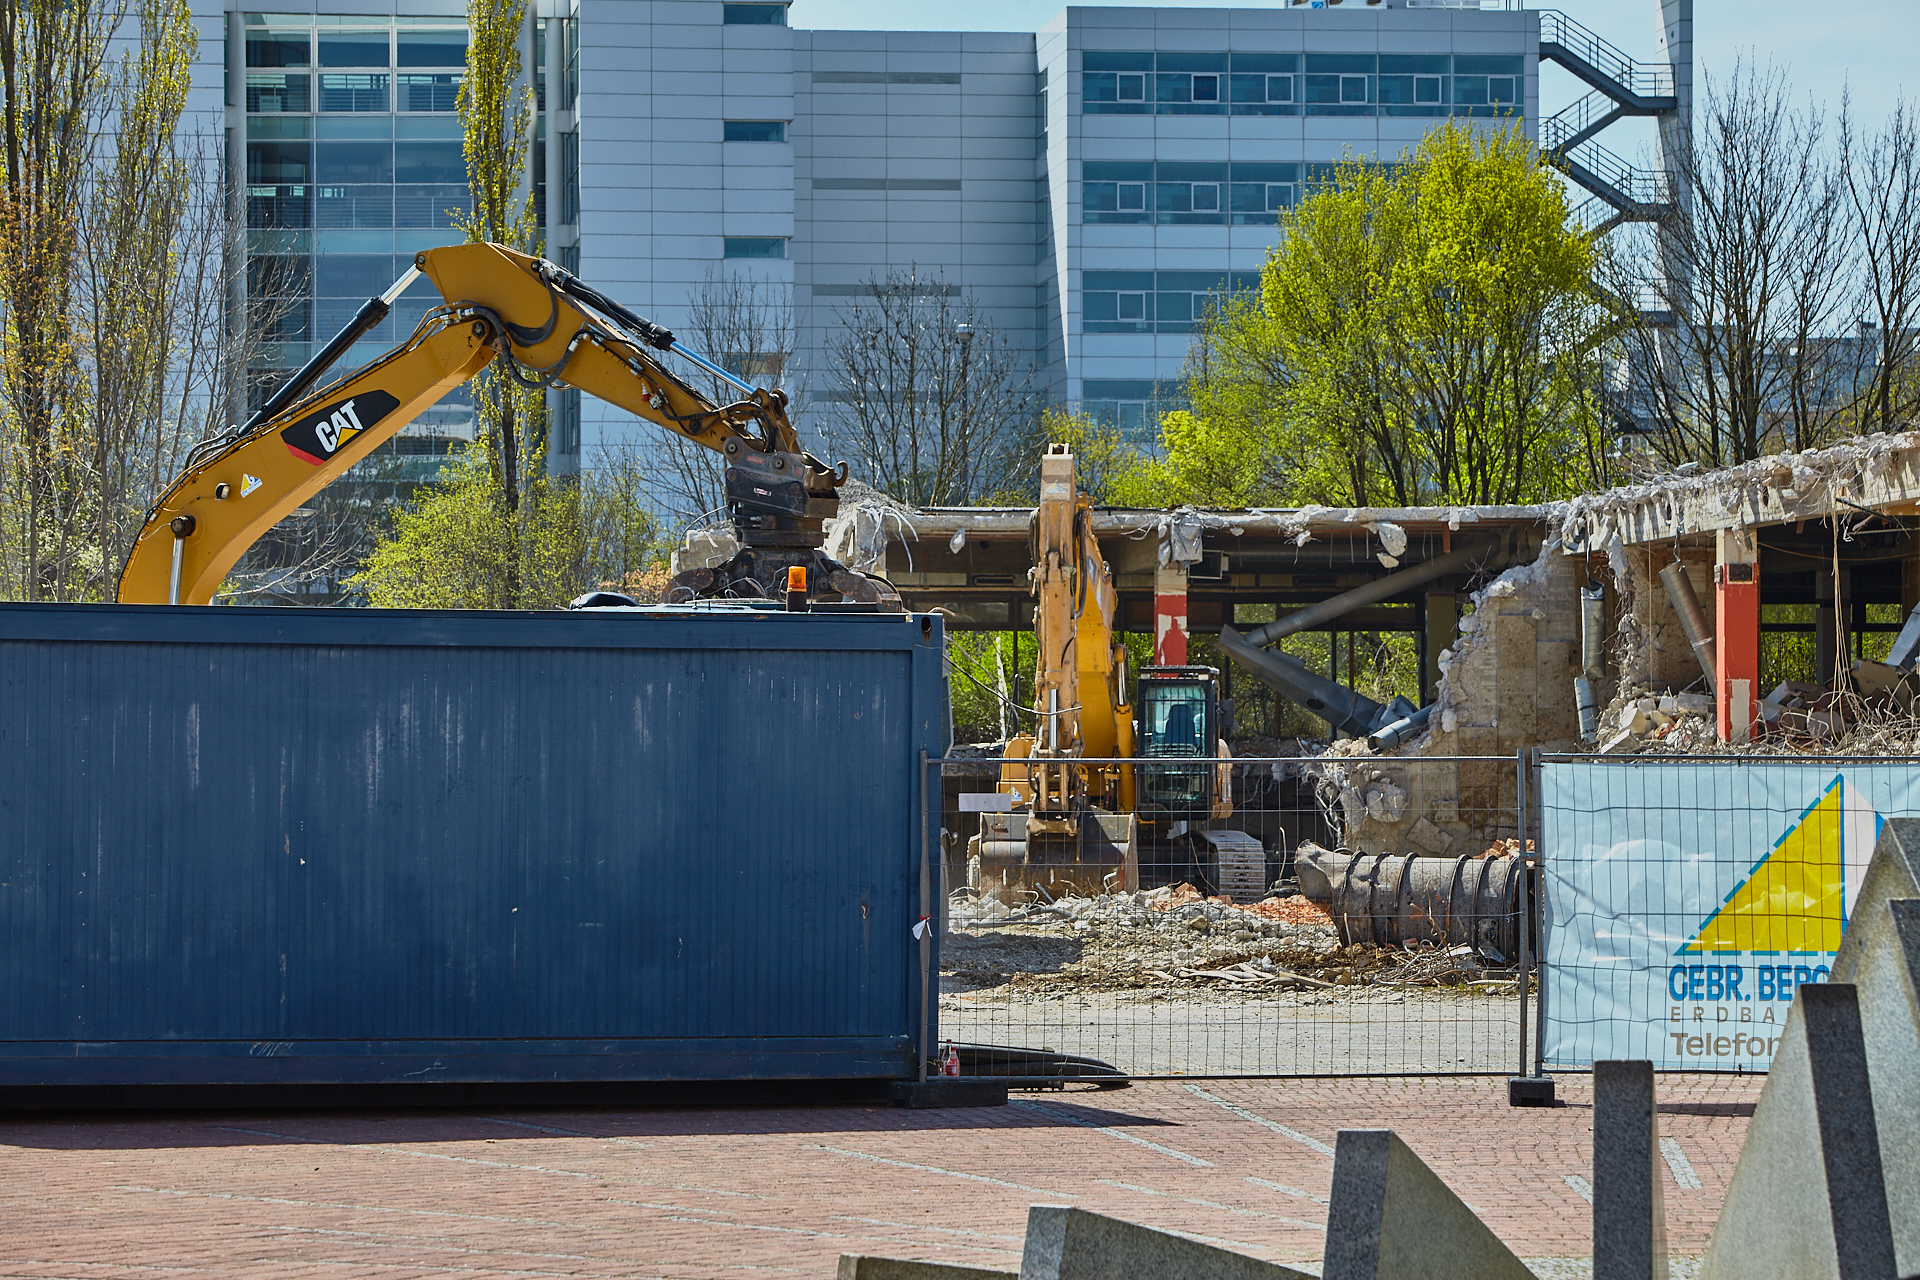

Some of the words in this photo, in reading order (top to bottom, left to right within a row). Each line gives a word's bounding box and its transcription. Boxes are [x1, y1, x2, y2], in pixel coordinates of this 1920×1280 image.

[315, 400, 364, 453] CAT
[1669, 964, 1751, 1001] GEBR.
[1670, 1007, 1791, 1023] ERDBA
